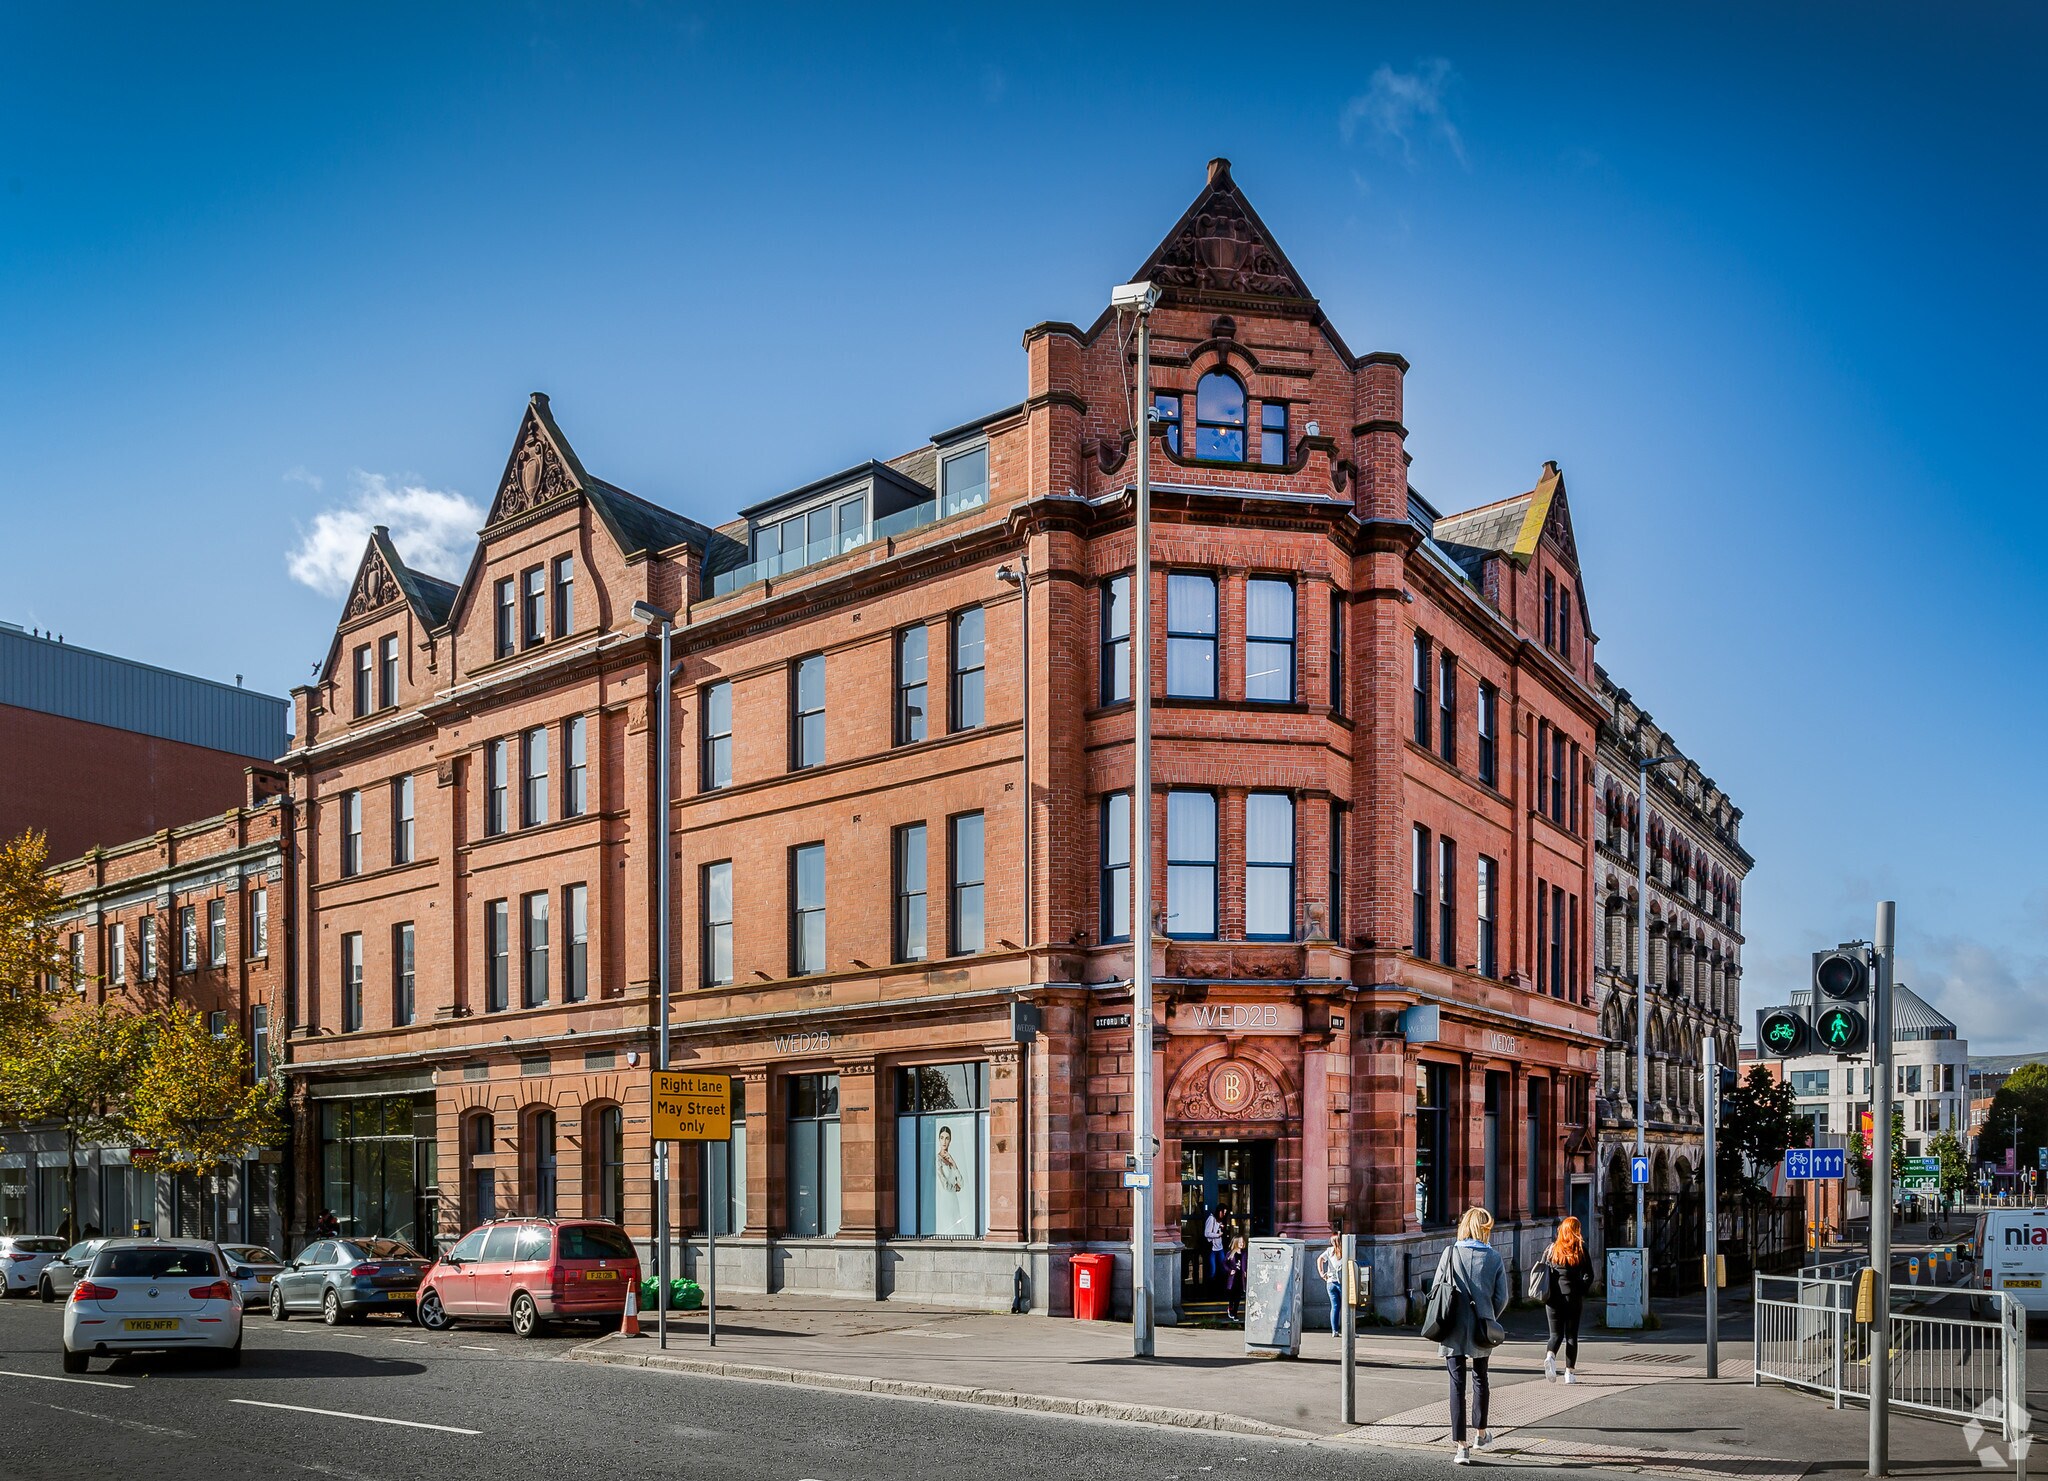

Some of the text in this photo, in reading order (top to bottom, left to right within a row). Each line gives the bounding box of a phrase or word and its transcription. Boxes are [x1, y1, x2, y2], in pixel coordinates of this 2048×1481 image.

[1095, 1017, 1118, 1027] OXFORD
[1192, 1005, 1278, 1027] WED2B
[1015, 1023, 1036, 1033] WED2B
[774, 1031, 831, 1054] WED2B
[1490, 1032, 1516, 1053] WED2B
[660, 1077, 723, 1093] Right lane
[657, 1100, 726, 1117] May Street
[679, 1119, 705, 1134] only
[2005, 1223, 2048, 1246] nia
[130, 1320, 173, 1331] YK16 NFR
